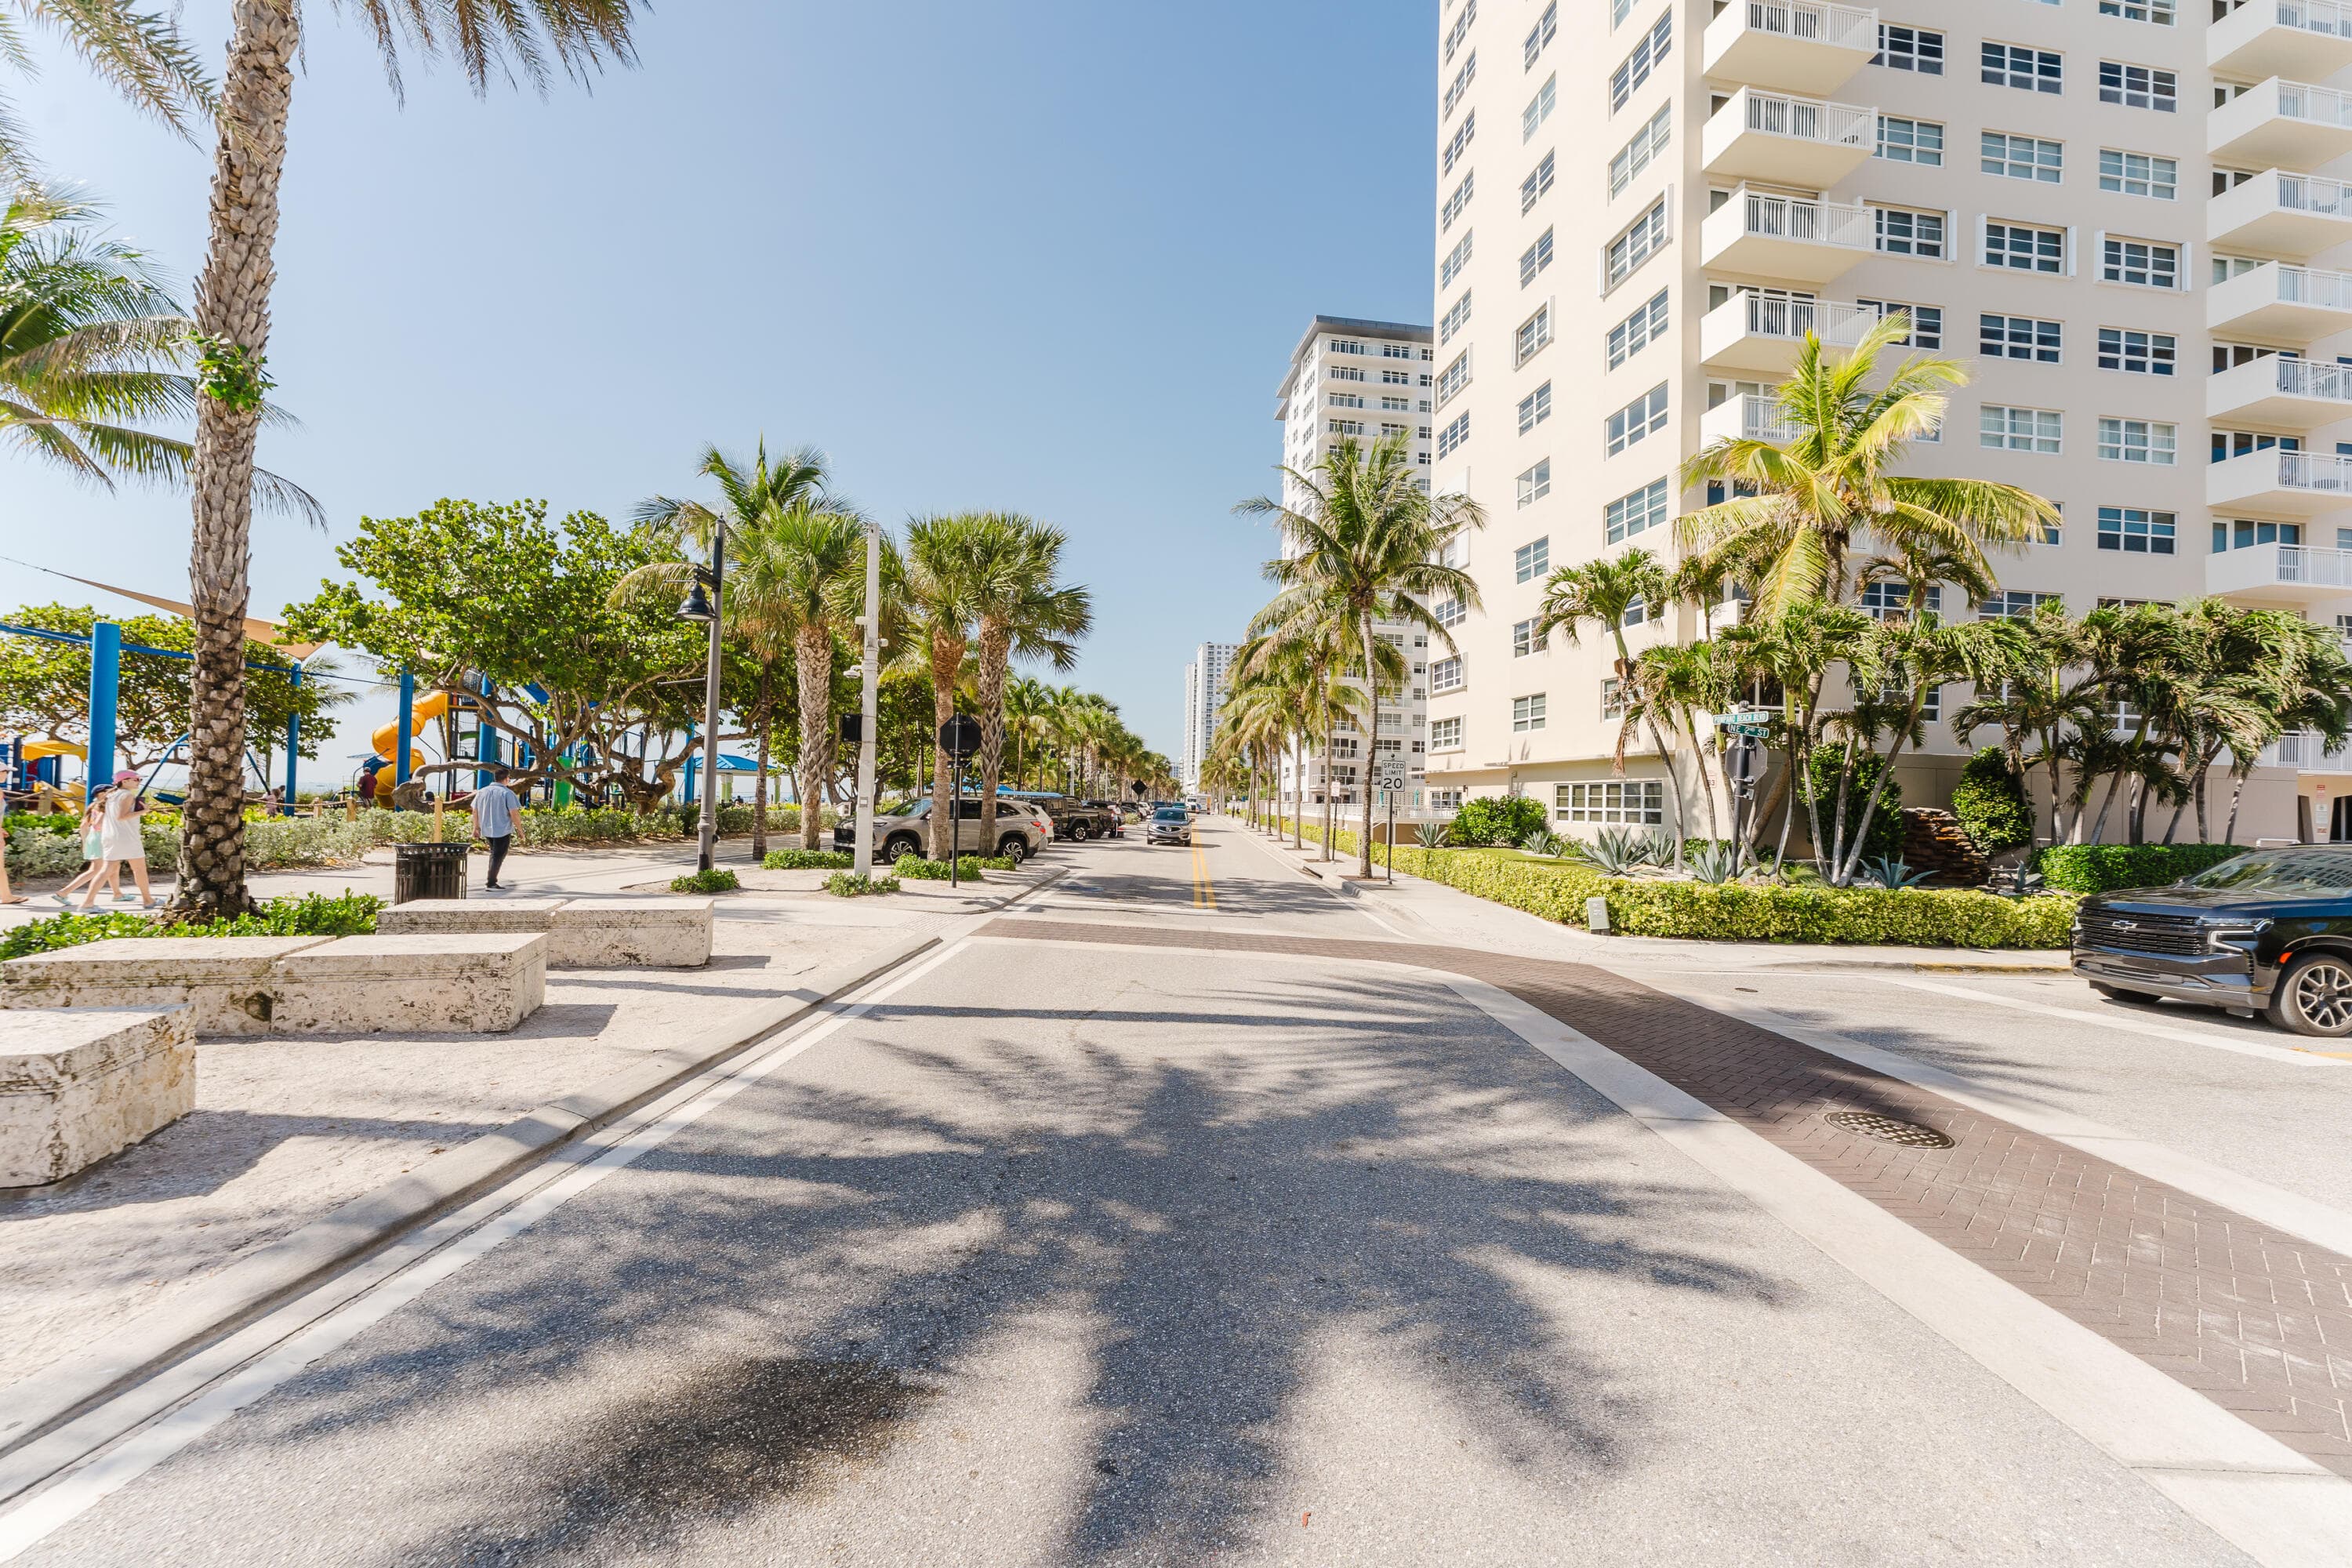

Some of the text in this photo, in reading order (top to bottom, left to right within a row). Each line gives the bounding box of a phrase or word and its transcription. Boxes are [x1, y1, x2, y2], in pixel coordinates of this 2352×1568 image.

[1753, 713, 1766, 721] BLVD
[1730, 724, 1741, 733] NE
[1758, 728, 1767, 737] ST
[1383, 778, 1403, 789] 20
